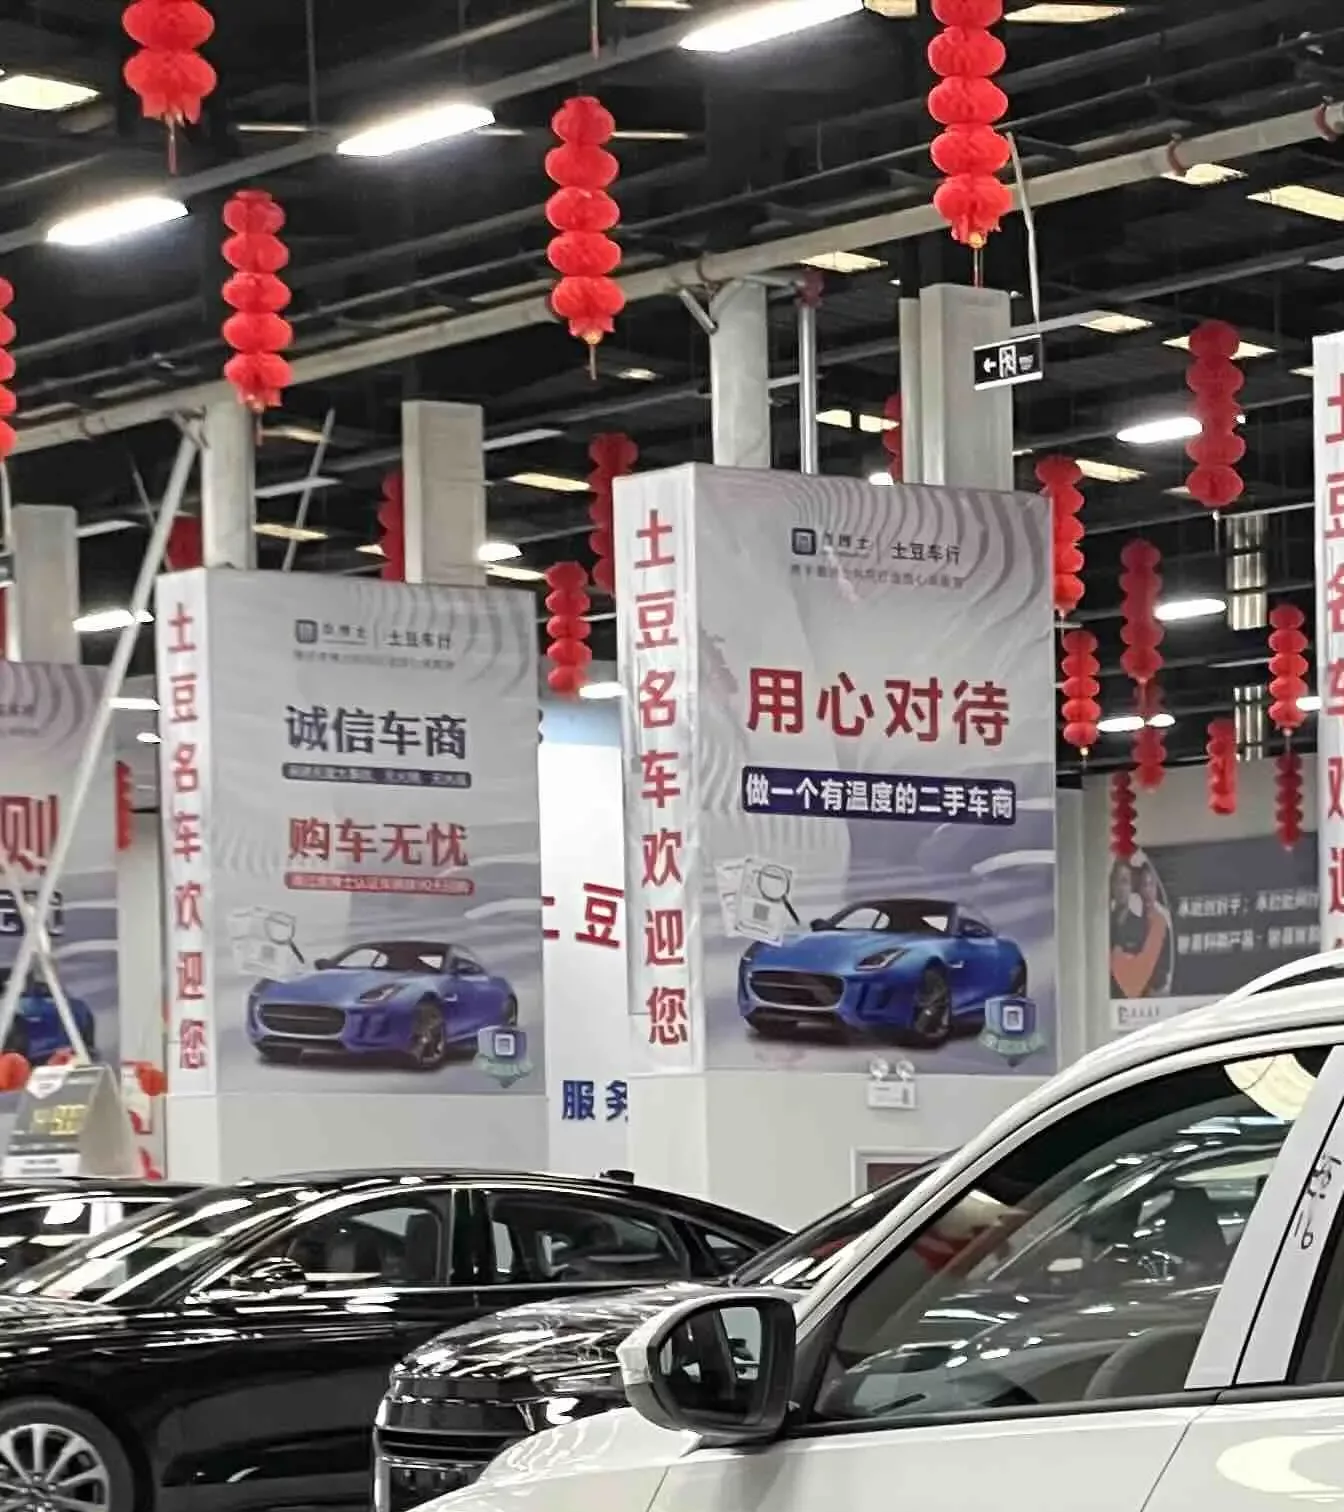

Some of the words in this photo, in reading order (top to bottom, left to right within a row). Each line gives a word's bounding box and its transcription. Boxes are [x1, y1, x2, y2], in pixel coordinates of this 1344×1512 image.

[891, 542, 960, 565] 土豆车行
[284, 704, 467, 760] 诚信车商
[746, 667, 1009, 746] 用心对待
[634, 509, 688, 1046] 土豆名车欢迎您
[745, 773, 1013, 819] 做一个有温度的二手车商
[168, 602, 208, 1071] 土豆名车欢迎您
[288, 817, 469, 868] 购车无忧
